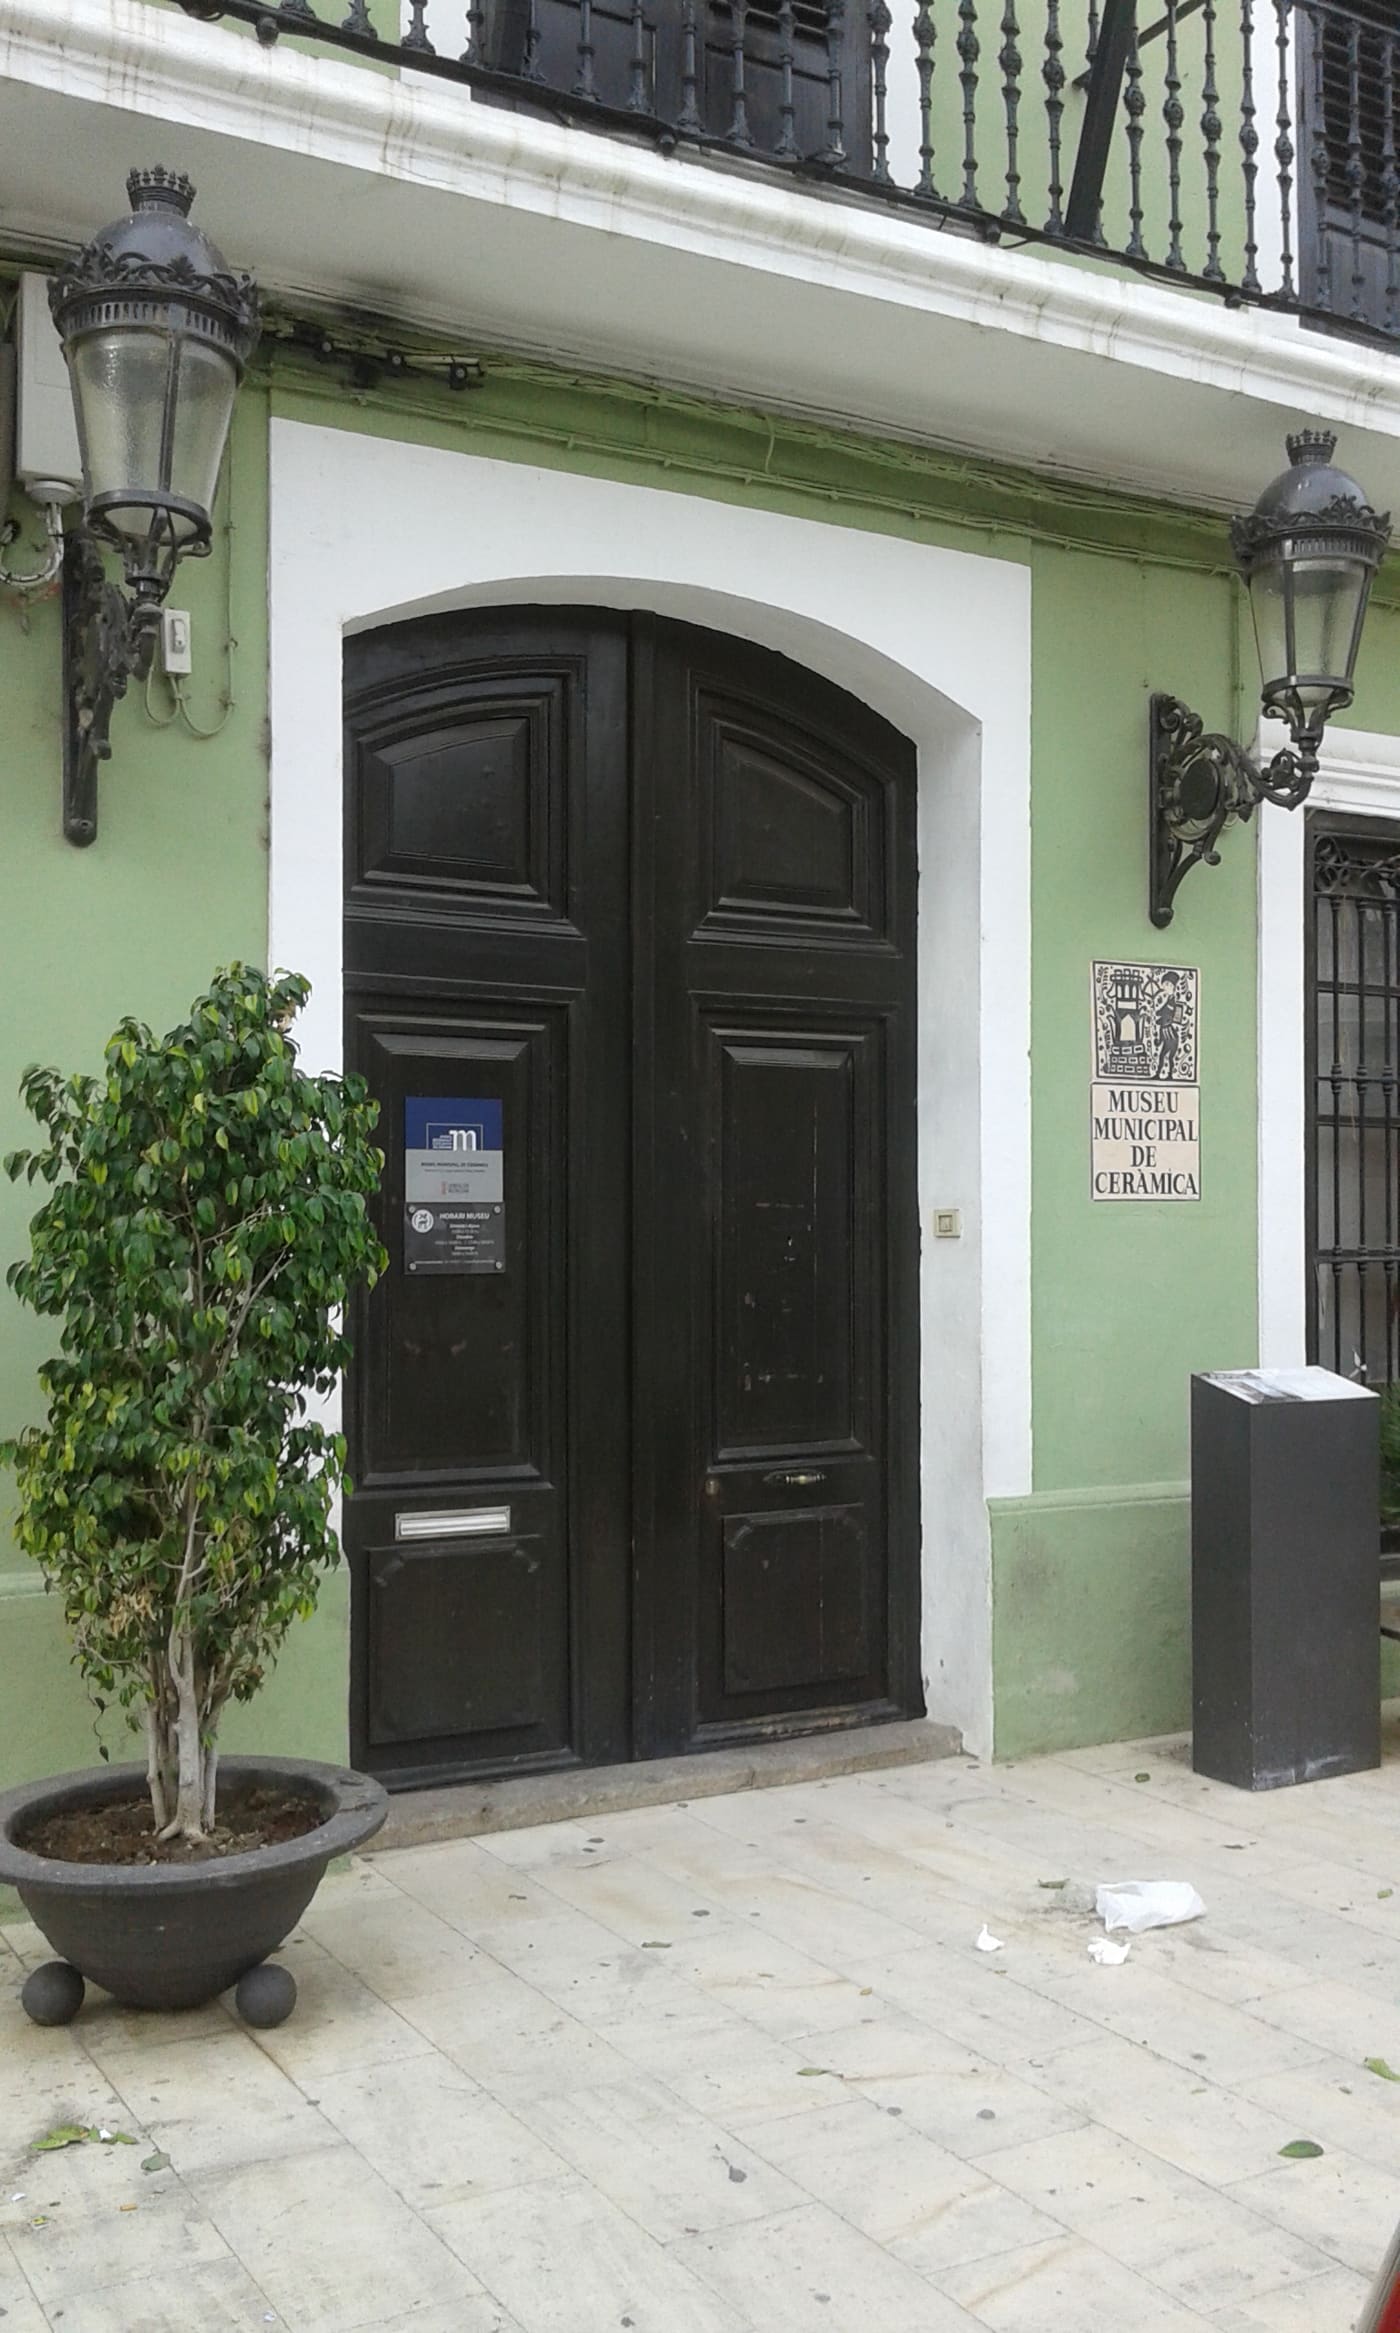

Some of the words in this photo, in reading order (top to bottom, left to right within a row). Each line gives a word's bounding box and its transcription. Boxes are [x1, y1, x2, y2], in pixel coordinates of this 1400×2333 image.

[1108, 1090, 1178, 1113] MUSEU
[1094, 1117, 1197, 1141] MUNICIPAL
[1130, 1145, 1157, 1168] DE
